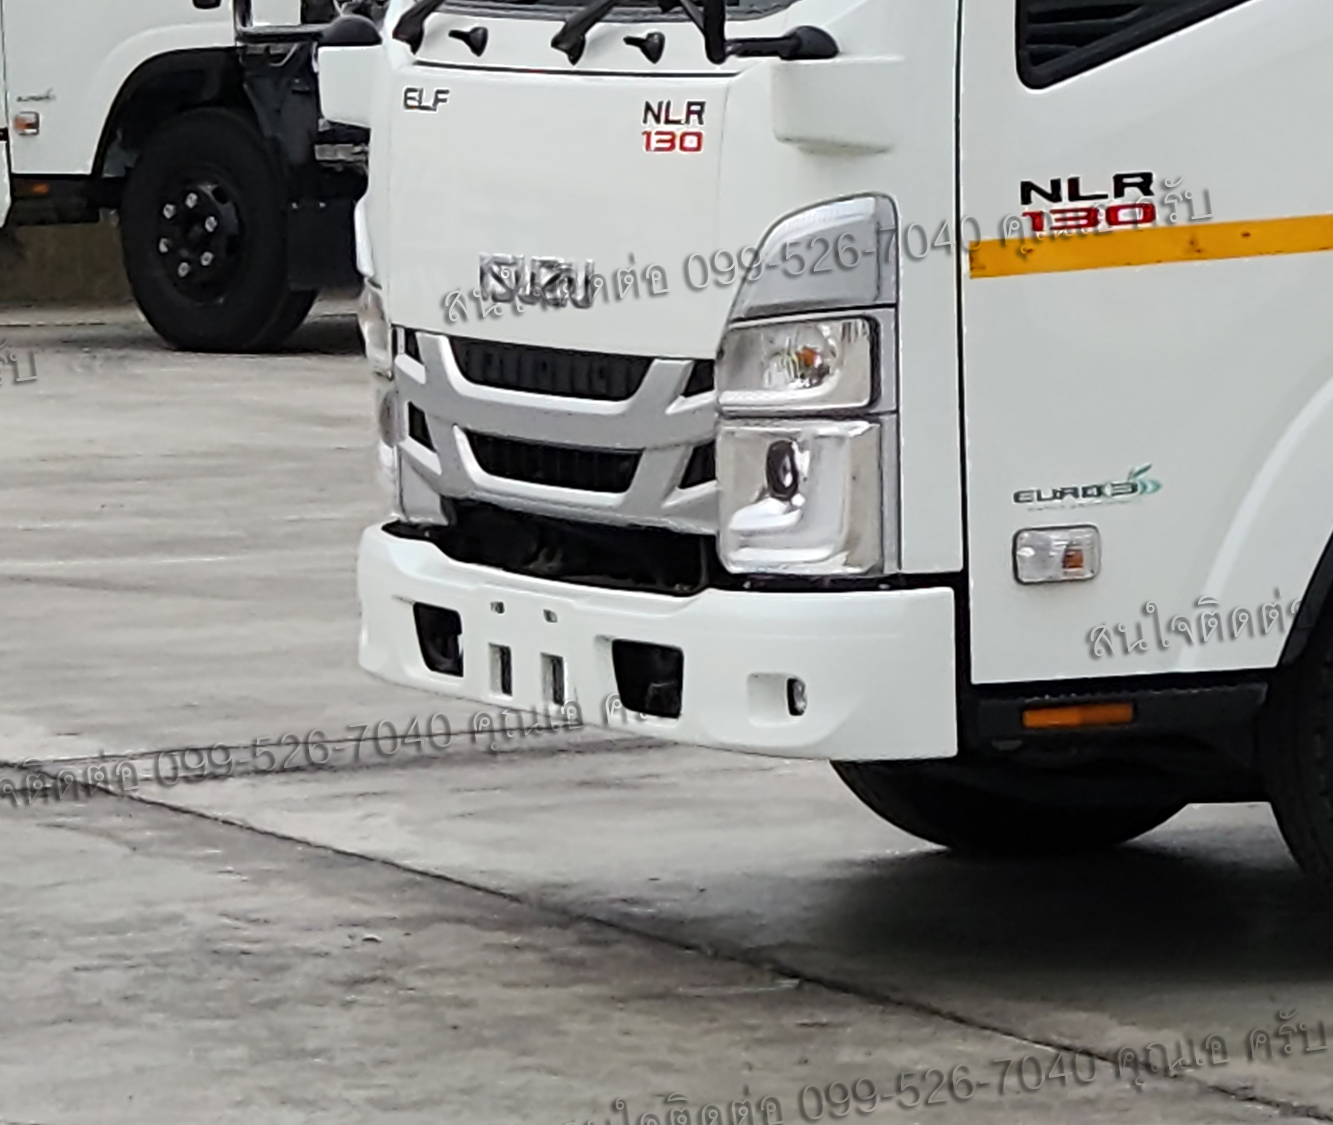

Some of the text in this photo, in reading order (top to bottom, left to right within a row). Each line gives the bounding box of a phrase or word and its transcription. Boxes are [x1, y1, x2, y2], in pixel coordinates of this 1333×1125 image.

[403, 88, 449, 111] ELF
[642, 100, 706, 125] NLR
[641, 130, 703, 152] 130
[1020, 172, 1155, 206] NLR
[1022, 202, 1156, 232] 130
